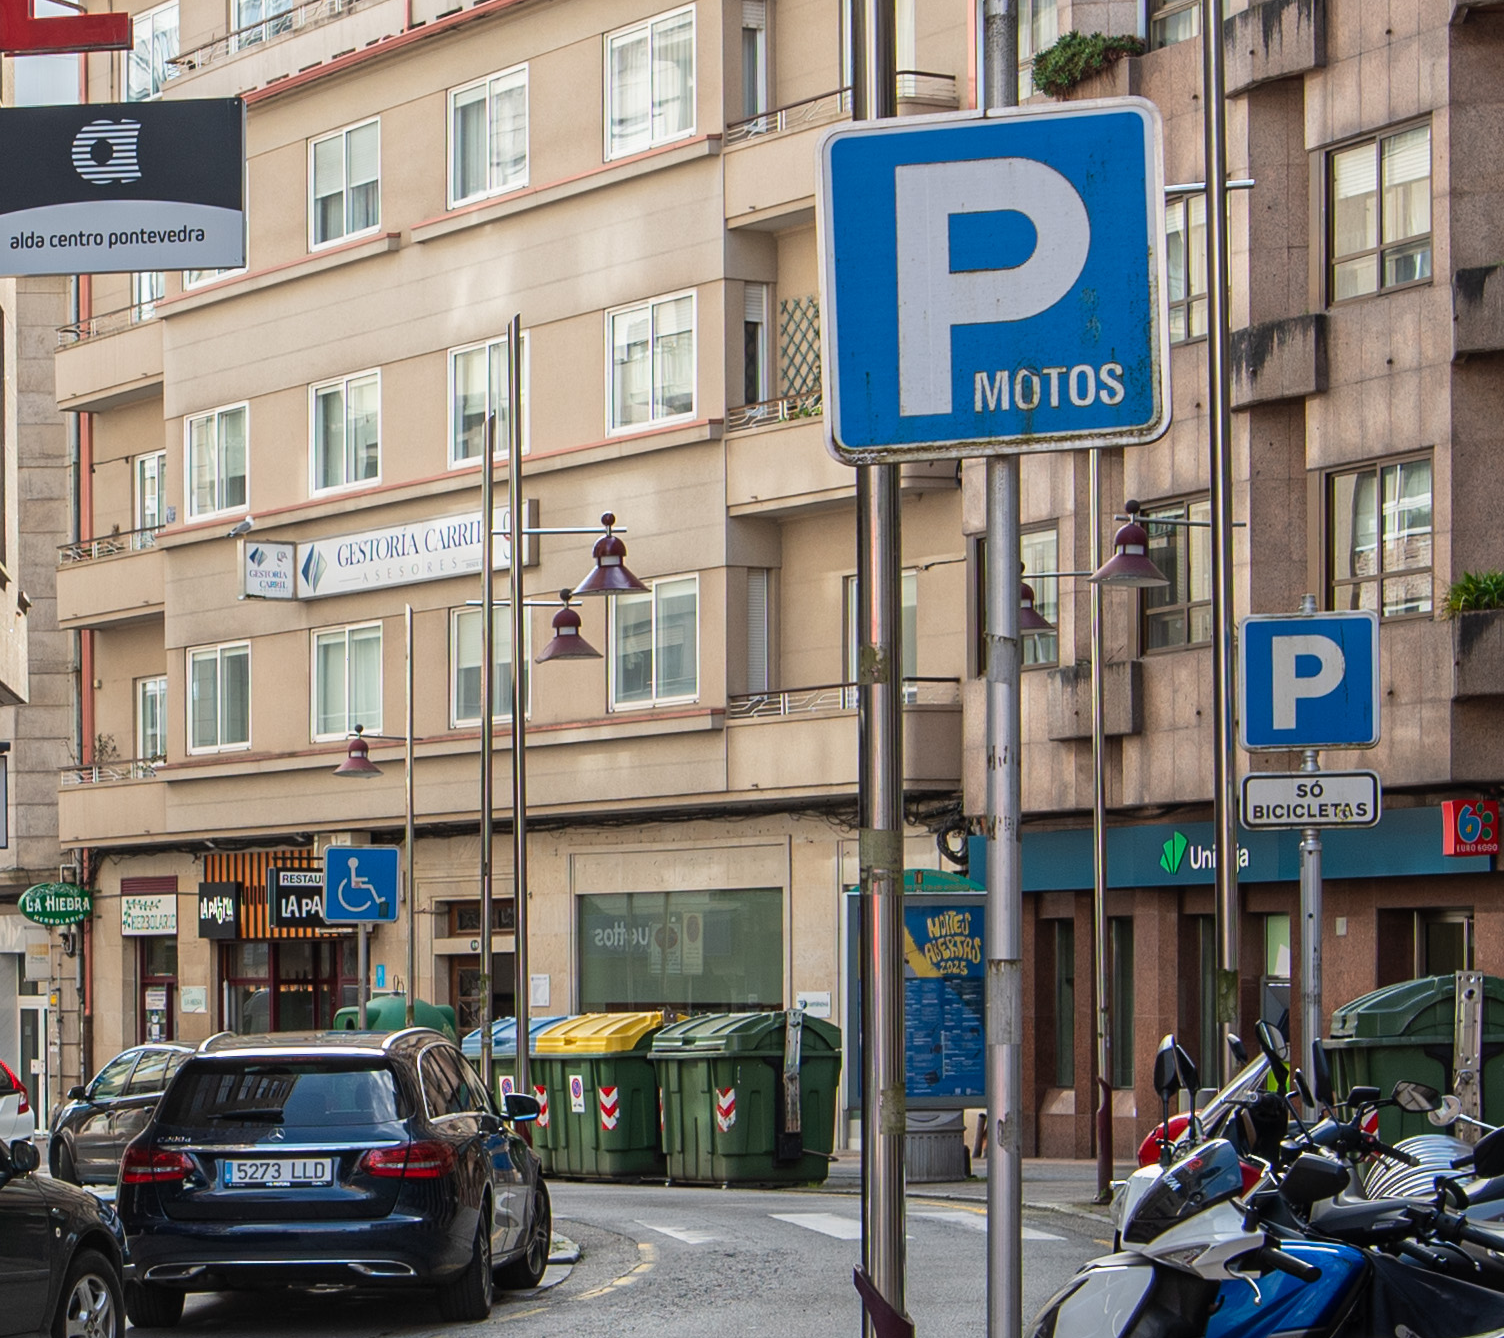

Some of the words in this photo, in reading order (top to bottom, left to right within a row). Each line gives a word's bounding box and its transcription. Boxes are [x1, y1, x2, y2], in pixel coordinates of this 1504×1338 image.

[10, 231, 45, 249] alda
[49, 230, 104, 248] centro
[108, 225, 206, 249] pontevedra
[895, 156, 1090, 417] P
[973, 362, 1126, 413] MOTOS
[337, 527, 420, 569] GESTORÍA
[361, 557, 458, 584] ASESORES
[1272, 634, 1346, 731] P
[1295, 780, 1324, 798] SÓ
[1252, 802, 1368, 820] BICICLETAS
[1477, 843, 1498, 852] 6000
[282, 873, 324, 884] RESTAU
[24, 896, 42, 912] LA
[281, 895, 300, 918] LA
[924, 936, 982, 964] ABERTAS
[939, 961, 968, 976] 2025
[237, 1162, 282, 1180] 5273
[291, 1162, 325, 1179] LLD
